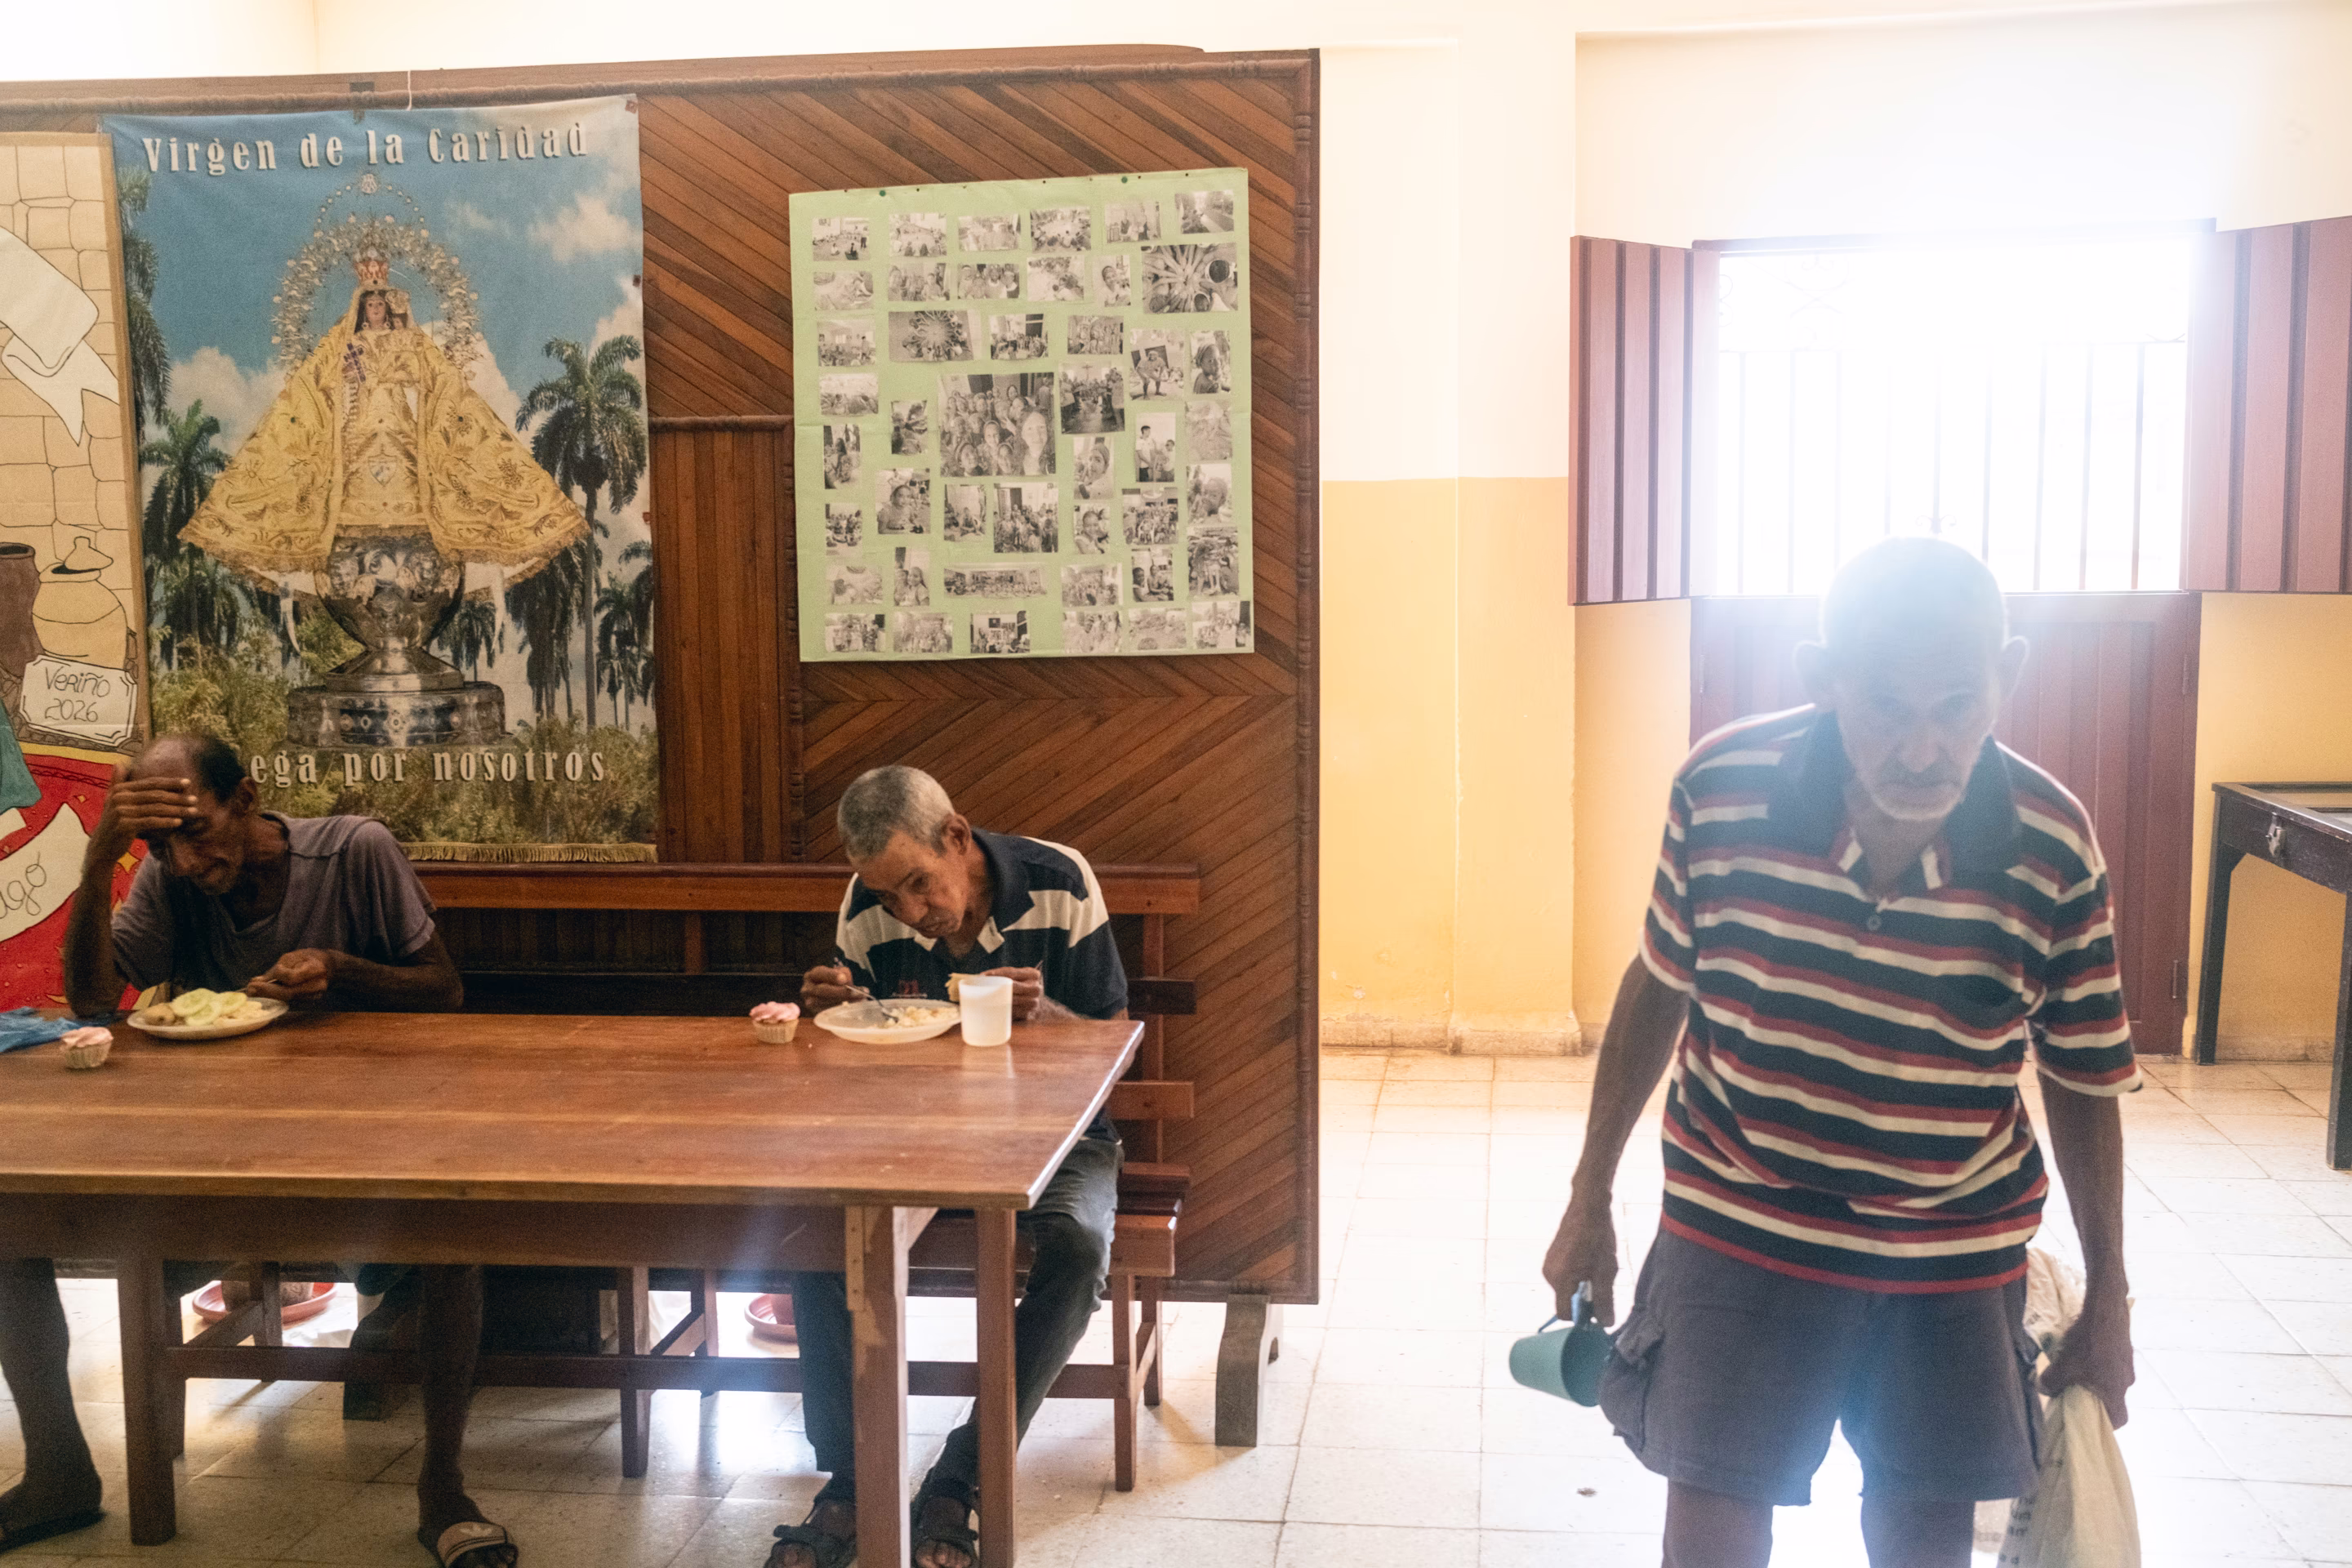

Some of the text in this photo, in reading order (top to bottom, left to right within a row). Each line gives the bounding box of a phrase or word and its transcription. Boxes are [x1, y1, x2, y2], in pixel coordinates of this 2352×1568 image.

[142, 122, 588, 176] Virgen de la Caridad
[44, 697, 99, 723] 2026
[250, 747, 605, 788] ega por nosotros
